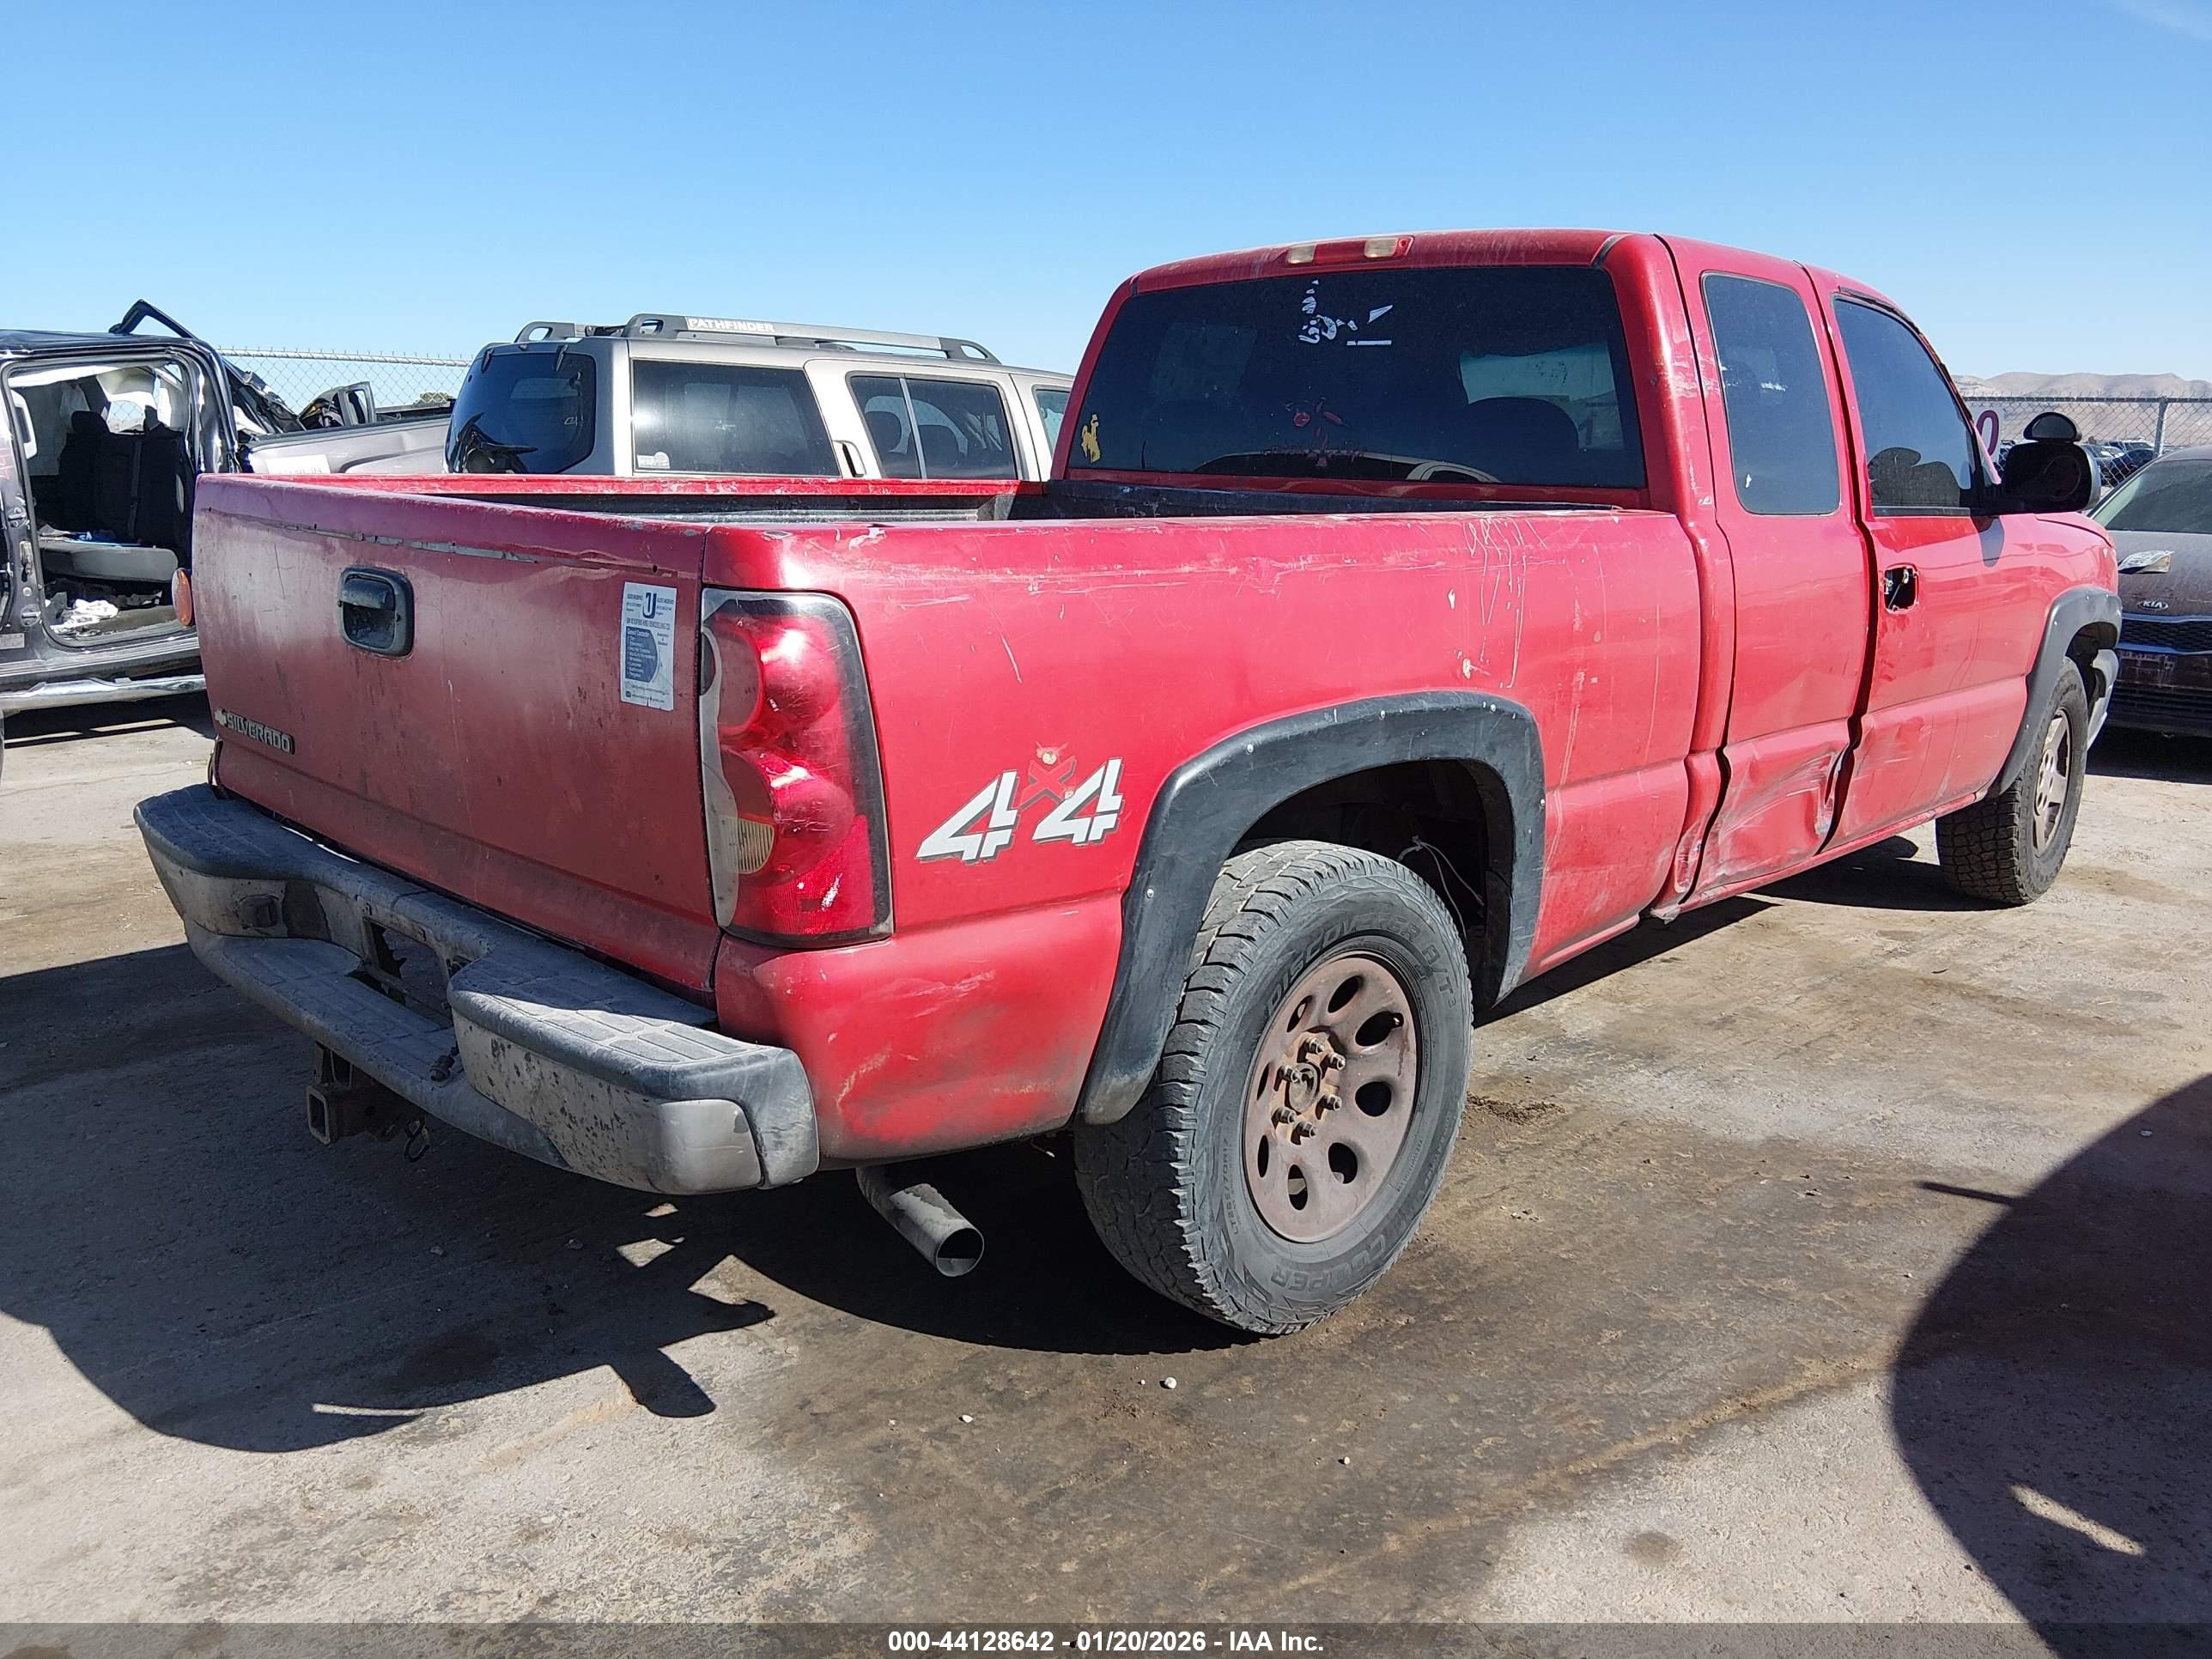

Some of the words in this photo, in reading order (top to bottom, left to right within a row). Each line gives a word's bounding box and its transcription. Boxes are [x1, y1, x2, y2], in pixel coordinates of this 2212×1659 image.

[688, 318, 776, 332] PATHFINDER
[2142, 600, 2163, 609] KIA
[226, 713, 291, 753] SILVERADO
[1268, 912, 1422, 1015] DISCOVERER
[1270, 1233, 1387, 1293] COOPER
